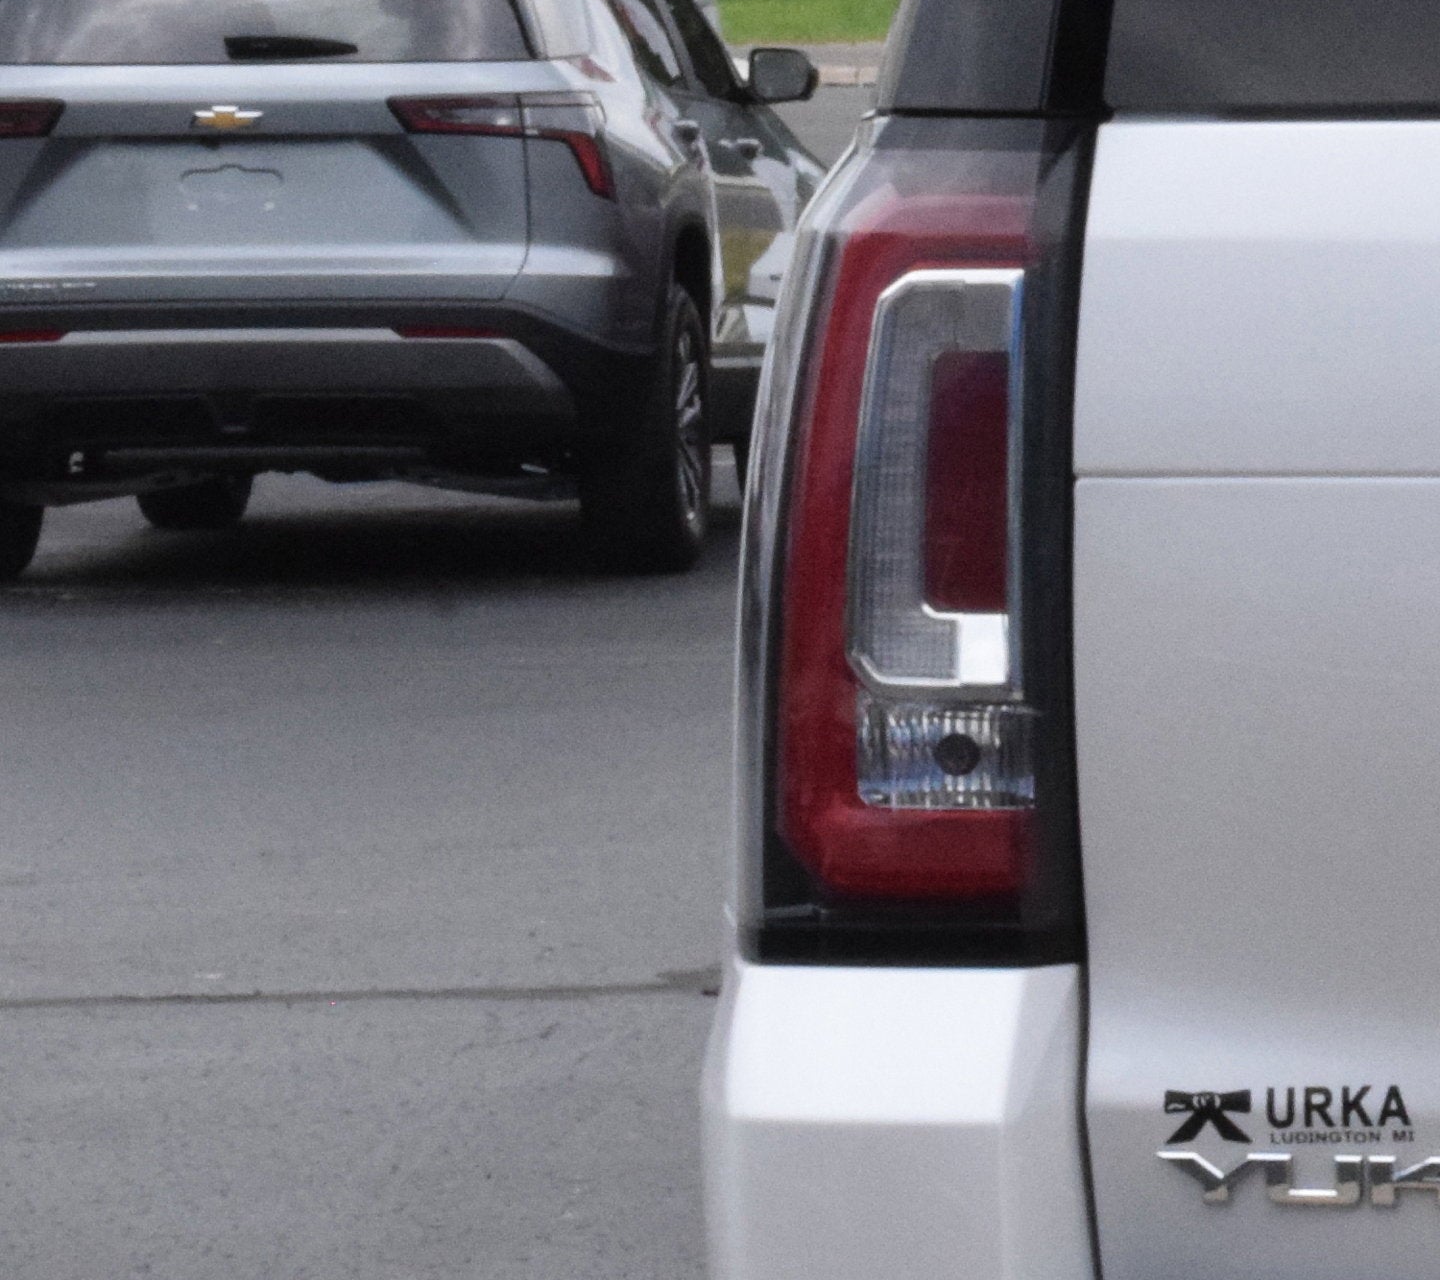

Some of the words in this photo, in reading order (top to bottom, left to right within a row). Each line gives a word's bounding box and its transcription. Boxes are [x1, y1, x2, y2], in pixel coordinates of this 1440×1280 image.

[1265, 1084, 1413, 1129] URKA
[1270, 1130, 1382, 1145] LUDINGTON
[1391, 1129, 1416, 1143] MI
